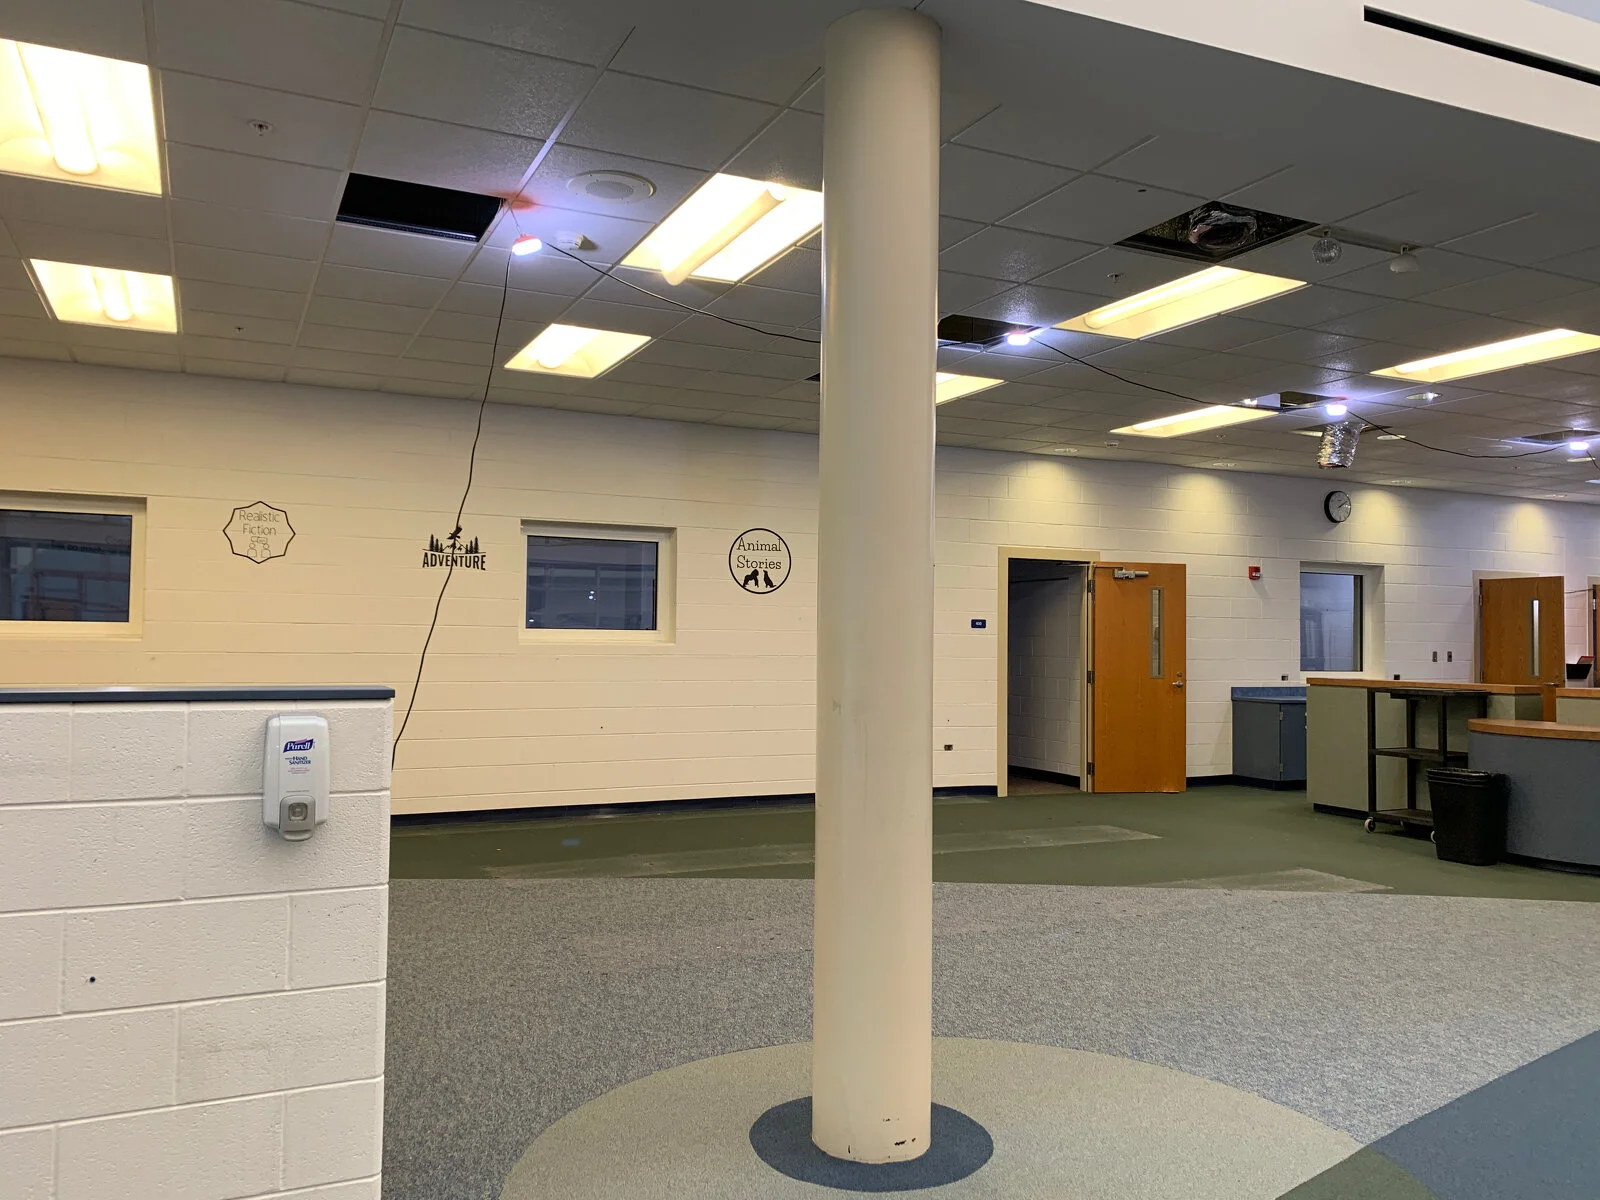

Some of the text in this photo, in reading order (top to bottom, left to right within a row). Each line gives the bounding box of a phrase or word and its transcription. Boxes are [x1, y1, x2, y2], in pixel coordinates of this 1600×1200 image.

[242, 524, 277, 536] Fiction
[736, 537, 782, 551] Animal
[422, 552, 486, 571] ADVENTURE
[736, 554, 782, 570] Stories
